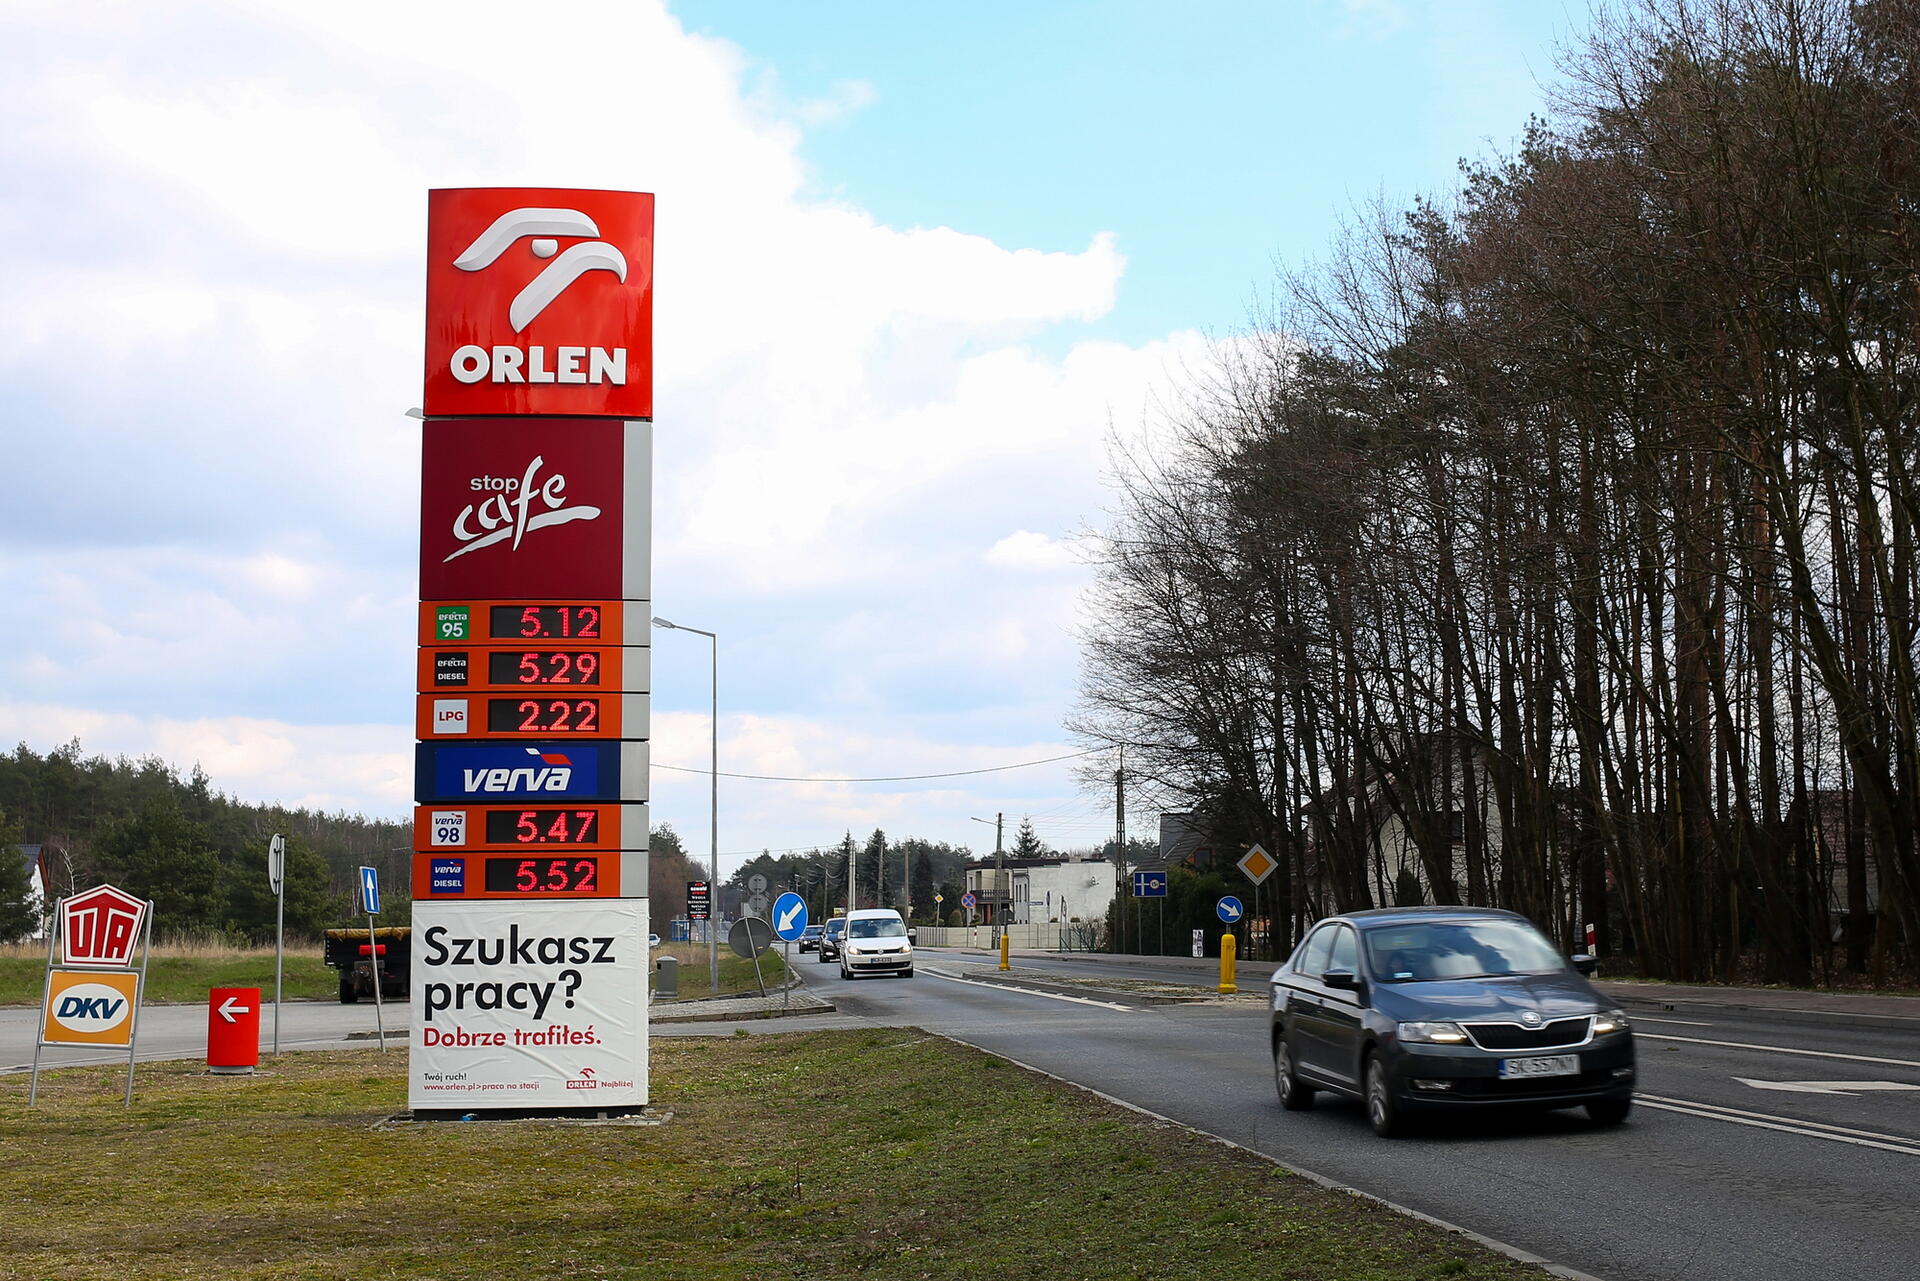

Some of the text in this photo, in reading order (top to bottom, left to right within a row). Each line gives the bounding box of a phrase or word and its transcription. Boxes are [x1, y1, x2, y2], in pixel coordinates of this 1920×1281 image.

[450, 344, 627, 385] ORLEN
[470, 473, 519, 495] stop
[453, 455, 567, 551] cafe
[438, 612, 468, 621] efecta
[520, 607, 598, 637] 5.12
[442, 623, 463, 638] 95
[437, 659, 467, 667] efecta
[519, 653, 597, 683] 5.29
[438, 672, 466, 681] DIESEL
[439, 711, 464, 721] LPG
[519, 700, 597, 731] 2.22
[463, 767, 572, 793] verva
[438, 827, 460, 843] 98
[517, 812, 595, 842] 5.47
[434, 866, 461, 874] verva
[516, 861, 595, 891] 5.52
[69, 892, 138, 959] UTA
[424, 923, 616, 966] Szukasz
[424, 969, 583, 1021] pracy?
[57, 996, 124, 1020] DKV
[423, 1026, 506, 1047] Dobrze
[514, 1024, 602, 1047] trafiłeś.
[424, 1072, 467, 1082] Twój ruch!
[519, 1081, 540, 1090] stacji
[567, 1080, 597, 1089] ORLEN
[601, 1080, 634, 1089] Najbliżej
